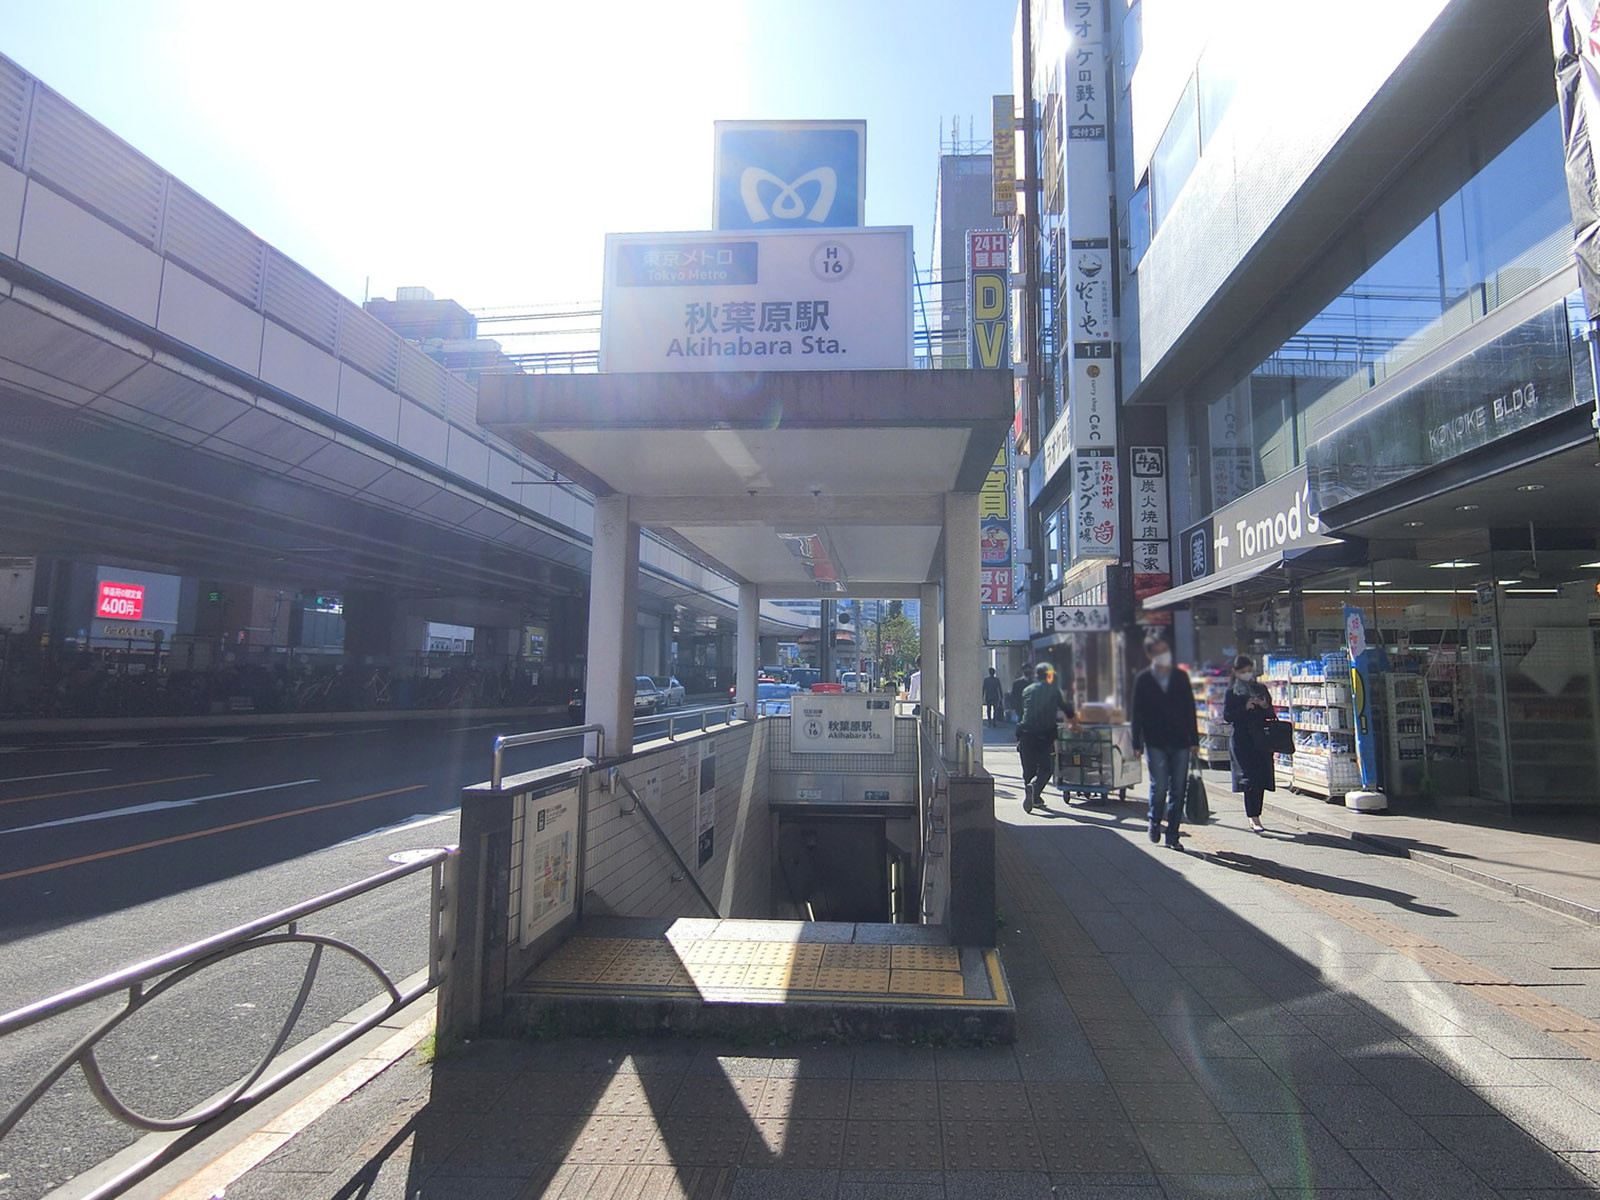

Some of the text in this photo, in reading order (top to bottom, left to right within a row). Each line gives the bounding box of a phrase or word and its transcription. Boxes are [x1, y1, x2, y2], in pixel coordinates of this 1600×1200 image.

[1071, 127, 1102, 137] 受付3F
[643, 249, 734, 266] 東京メトロ
[826, 248, 838, 259] H
[975, 252, 1006, 267] 営業
[647, 268, 727, 282] Tokyo Metro
[822, 261, 843, 273] 16
[684, 301, 830, 334] 秋葉原駅
[666, 335, 847, 357] Akihabara Sta.
[1085, 346, 1102, 356] 1F
[1089, 414, 1101, 440] C&C
[1137, 453, 1161, 474] 牛角
[1077, 461, 1098, 543] テング酒場
[1140, 479, 1159, 539] 炭火焼肉
[1236, 478, 1320, 559] Tomod's
[1141, 543, 1160, 571] 酒家
[981, 571, 1009, 585] 受付
[981, 587, 1008, 602] 2F
[828, 721, 872, 732] 秋葉原駅
